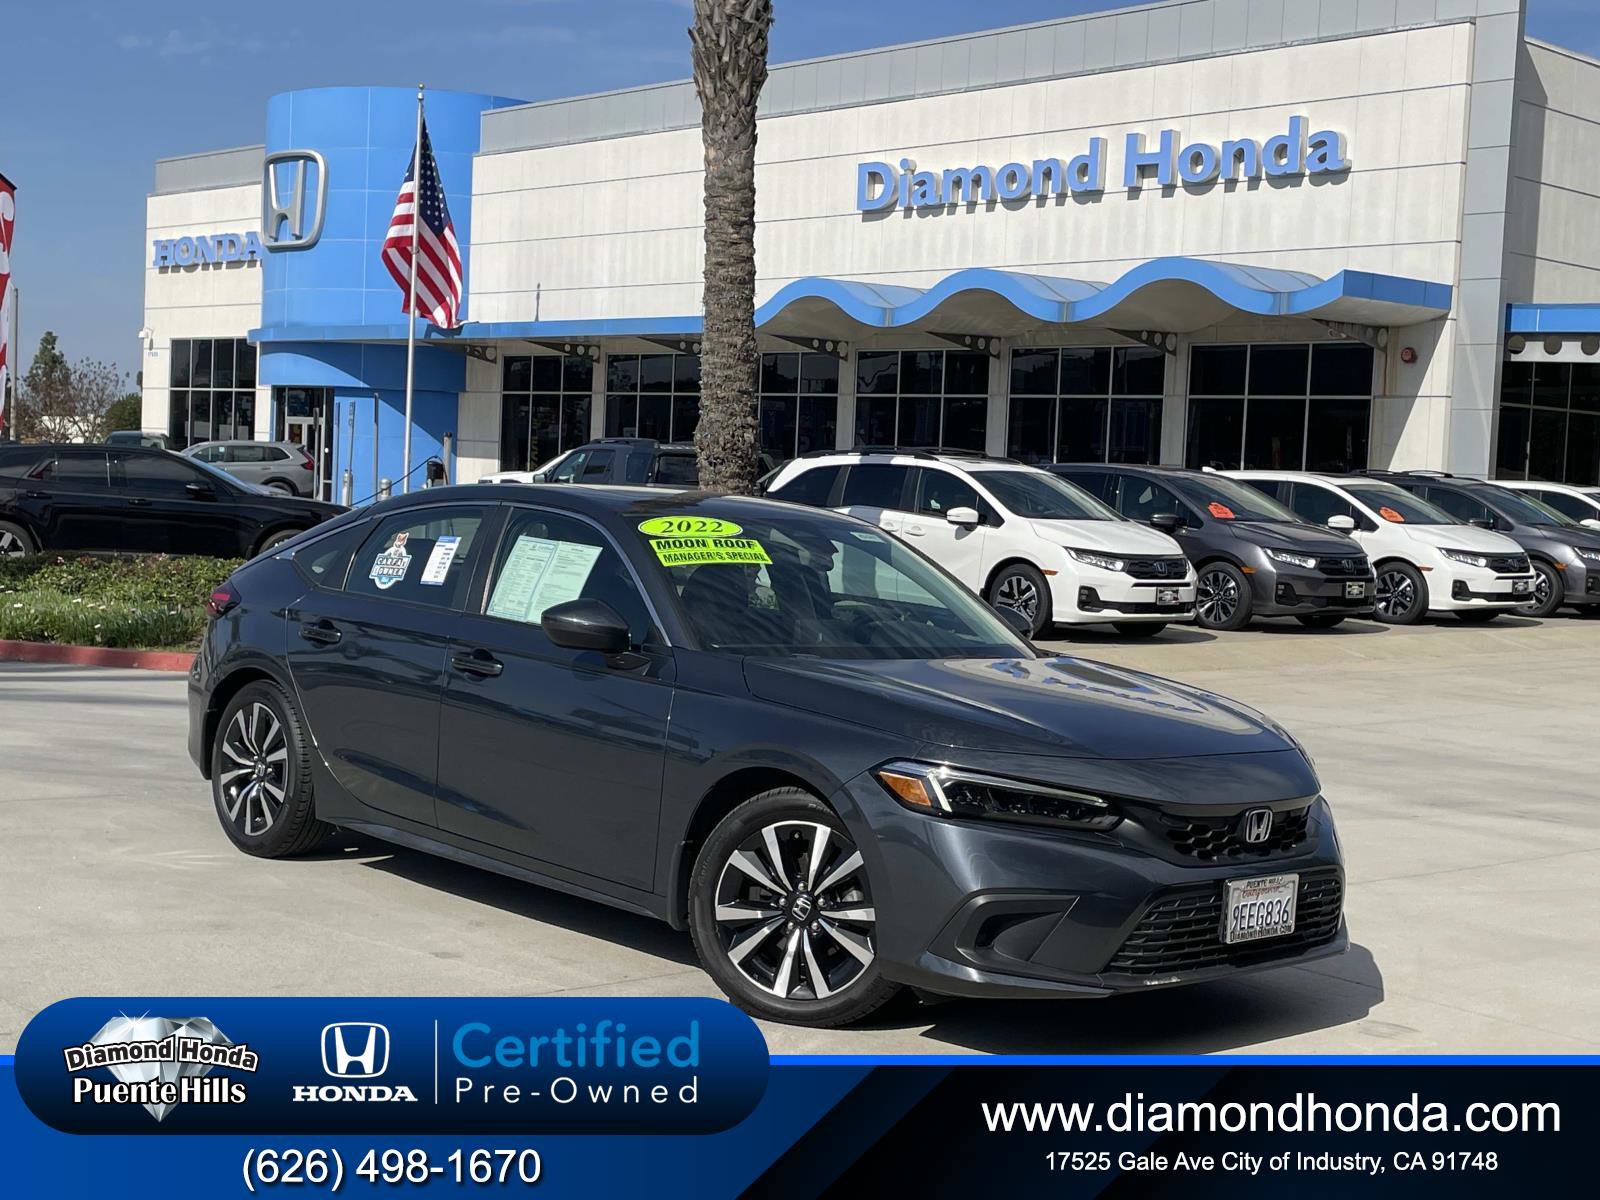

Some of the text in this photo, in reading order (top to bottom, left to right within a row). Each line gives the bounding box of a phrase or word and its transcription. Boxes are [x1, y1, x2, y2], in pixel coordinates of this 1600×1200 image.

[857, 115, 1351, 212] Diamond Honda
[153, 231, 262, 267] HONDA
[660, 520, 724, 533] 2022
[656, 539, 757, 550] MOON ROOF
[663, 551, 768, 563] MANAGER'S SPECIAL
[1232, 896, 1292, 931] 9EEG836
